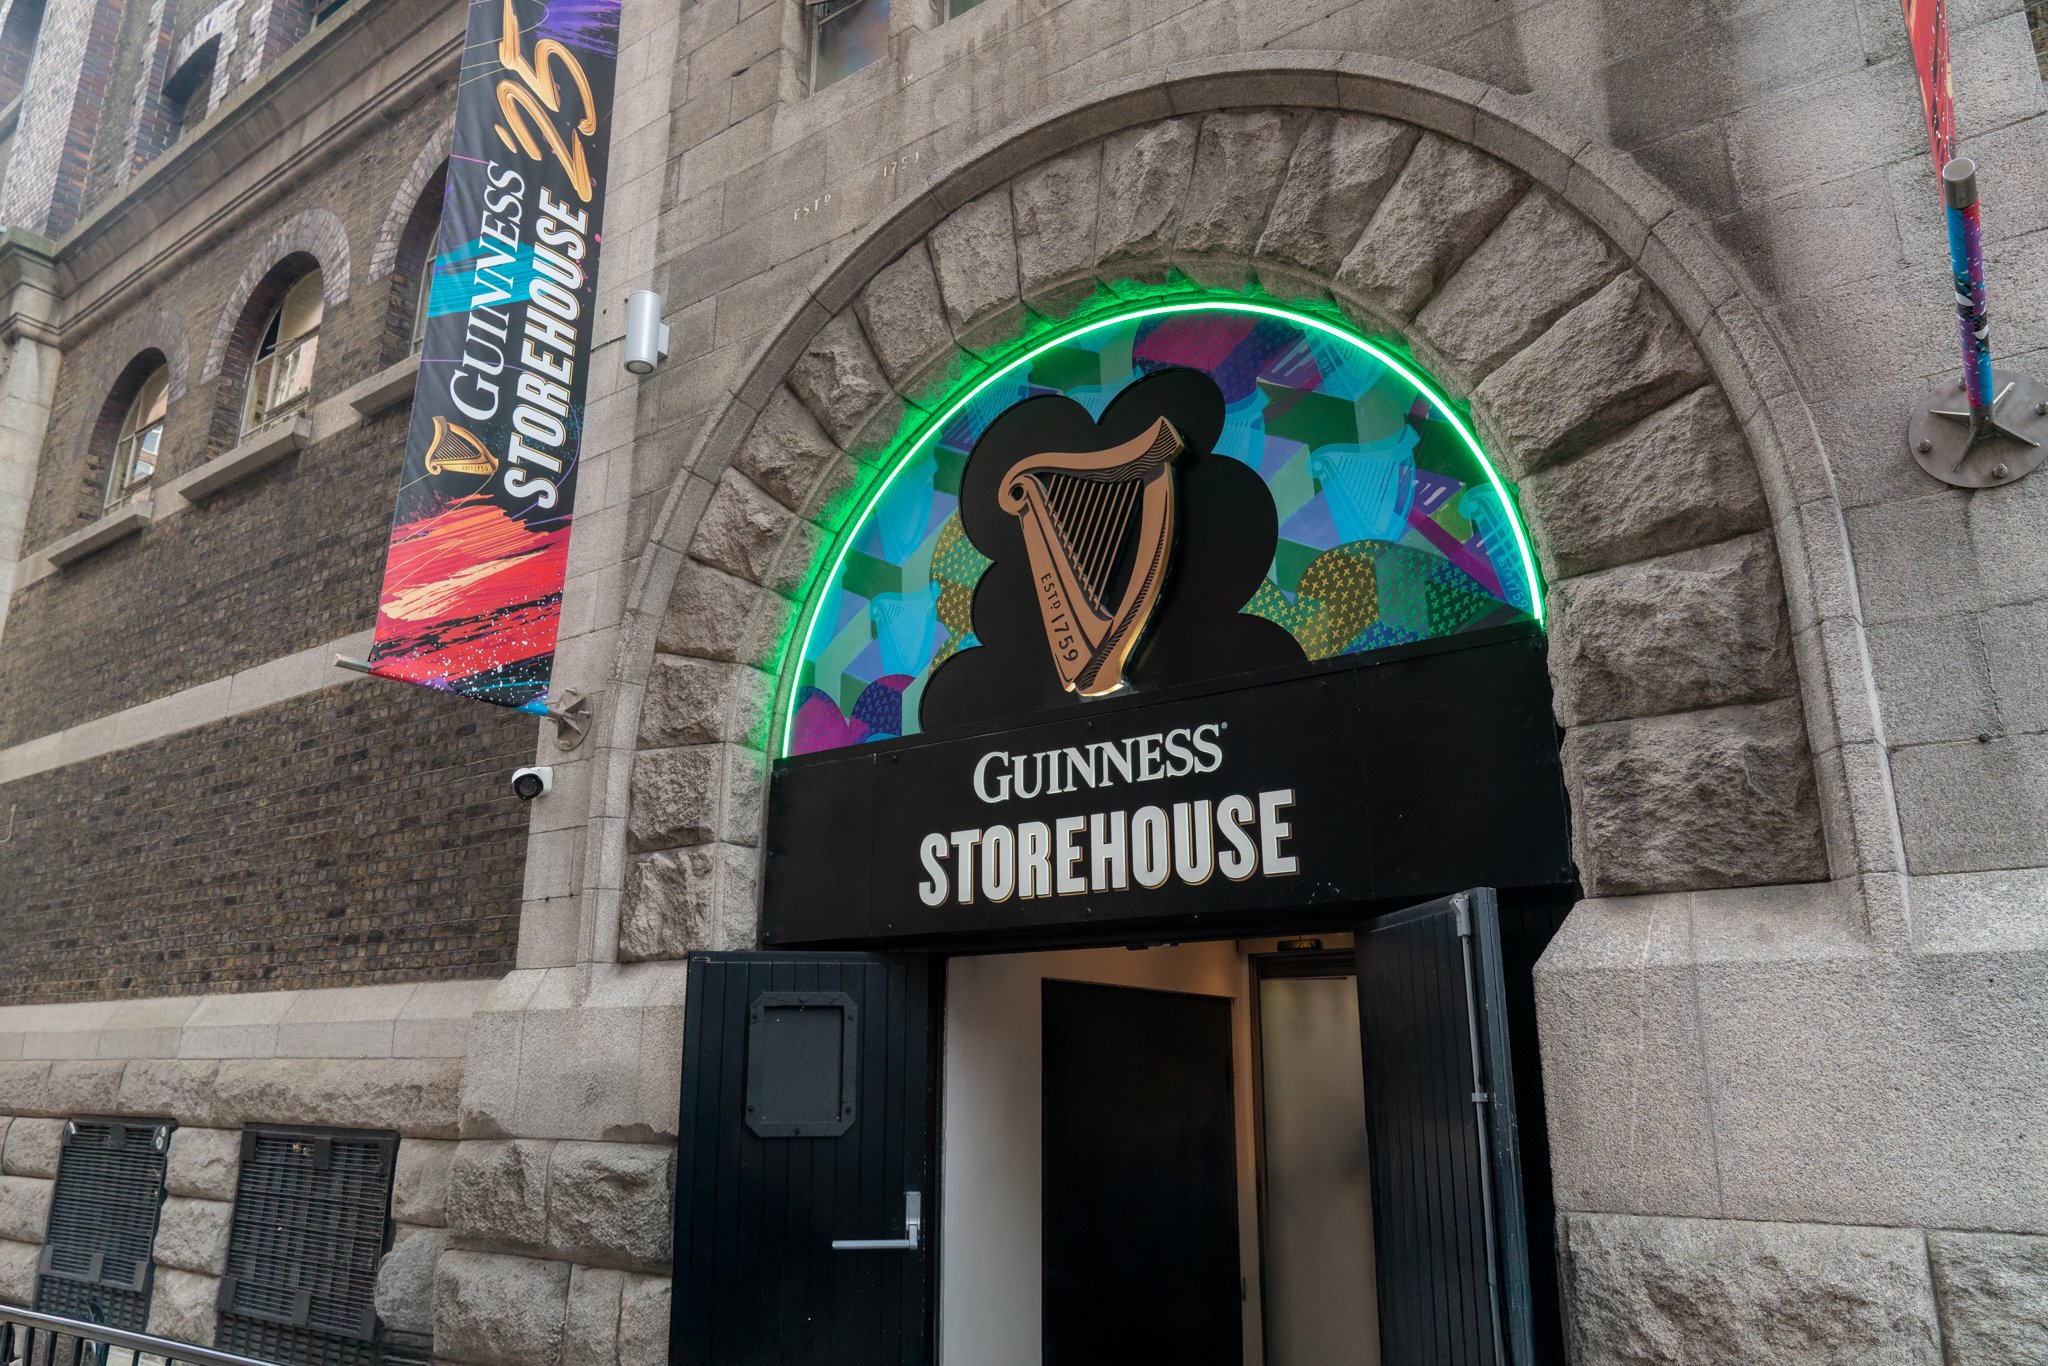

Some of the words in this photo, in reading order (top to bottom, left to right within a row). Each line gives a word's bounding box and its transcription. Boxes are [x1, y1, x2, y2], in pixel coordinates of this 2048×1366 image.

[449, 160, 526, 422] GUINNESS
[503, 186, 588, 510] STOREHOUSE
[1050, 613, 1079, 662] 1759
[1505, 580, 1529, 608] 1759
[973, 722, 1223, 804] GUINNESS
[918, 788, 1300, 908] STOREHOUSE
